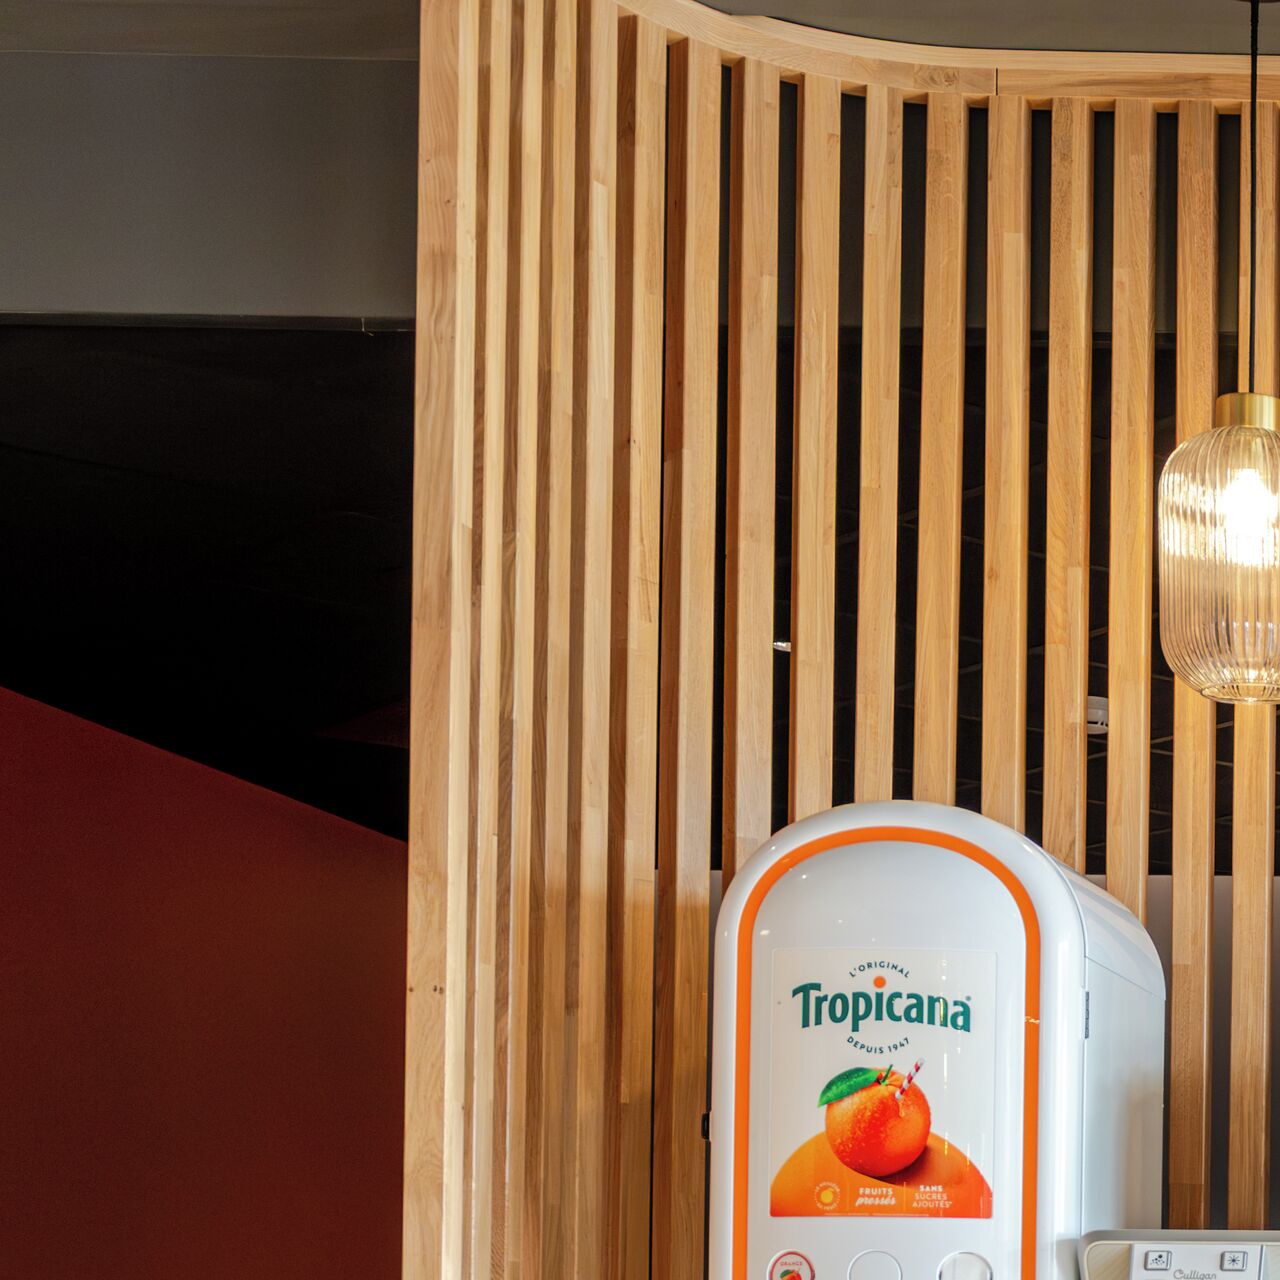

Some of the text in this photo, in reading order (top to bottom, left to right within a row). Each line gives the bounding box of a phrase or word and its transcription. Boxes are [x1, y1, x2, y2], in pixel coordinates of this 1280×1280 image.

[849, 960, 911, 978] L'ORIGINAL
[792, 976, 971, 1032] Tropicana
[847, 1036, 910, 1054] DEPUIS 1947
[859, 1187, 893, 1195] FRUITS
[919, 1184, 943, 1192] SANS
[914, 1193, 947, 1201] SUCRES
